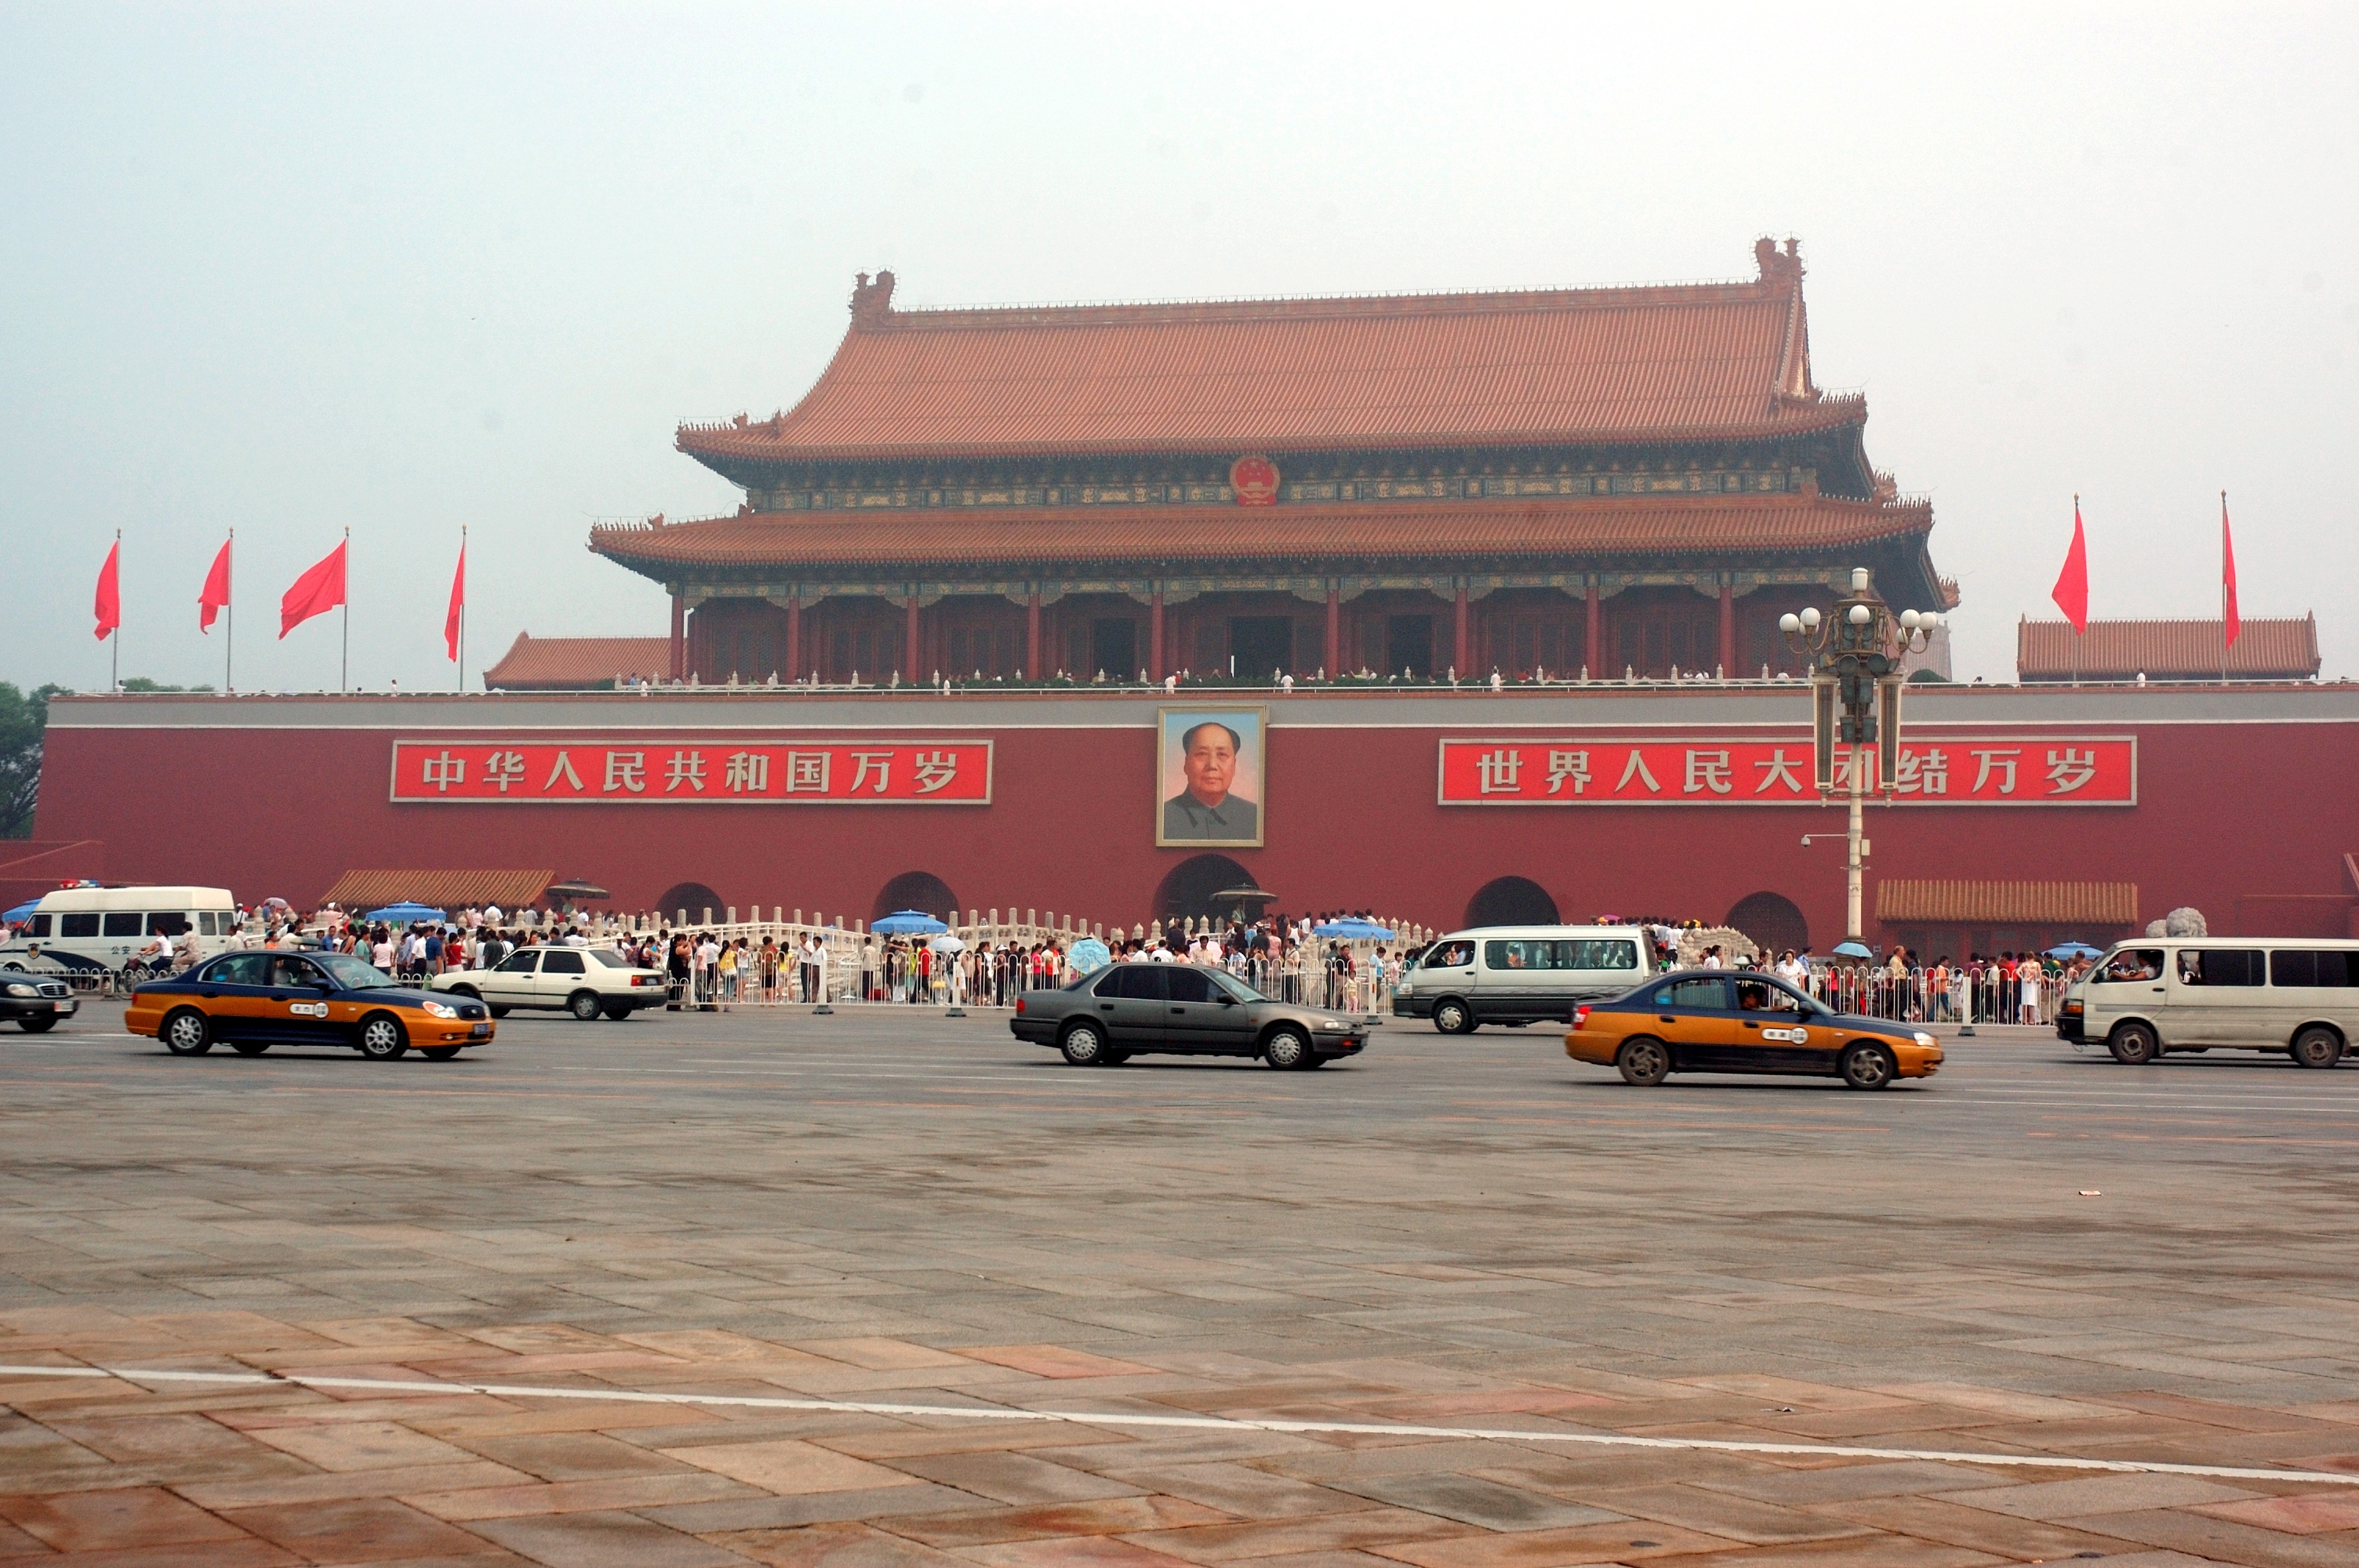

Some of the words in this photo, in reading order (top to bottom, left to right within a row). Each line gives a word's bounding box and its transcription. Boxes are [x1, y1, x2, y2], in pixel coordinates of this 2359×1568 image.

[423, 750, 957, 793] 中华人民共和国万岁
[111, 946, 130, 954] 公安
